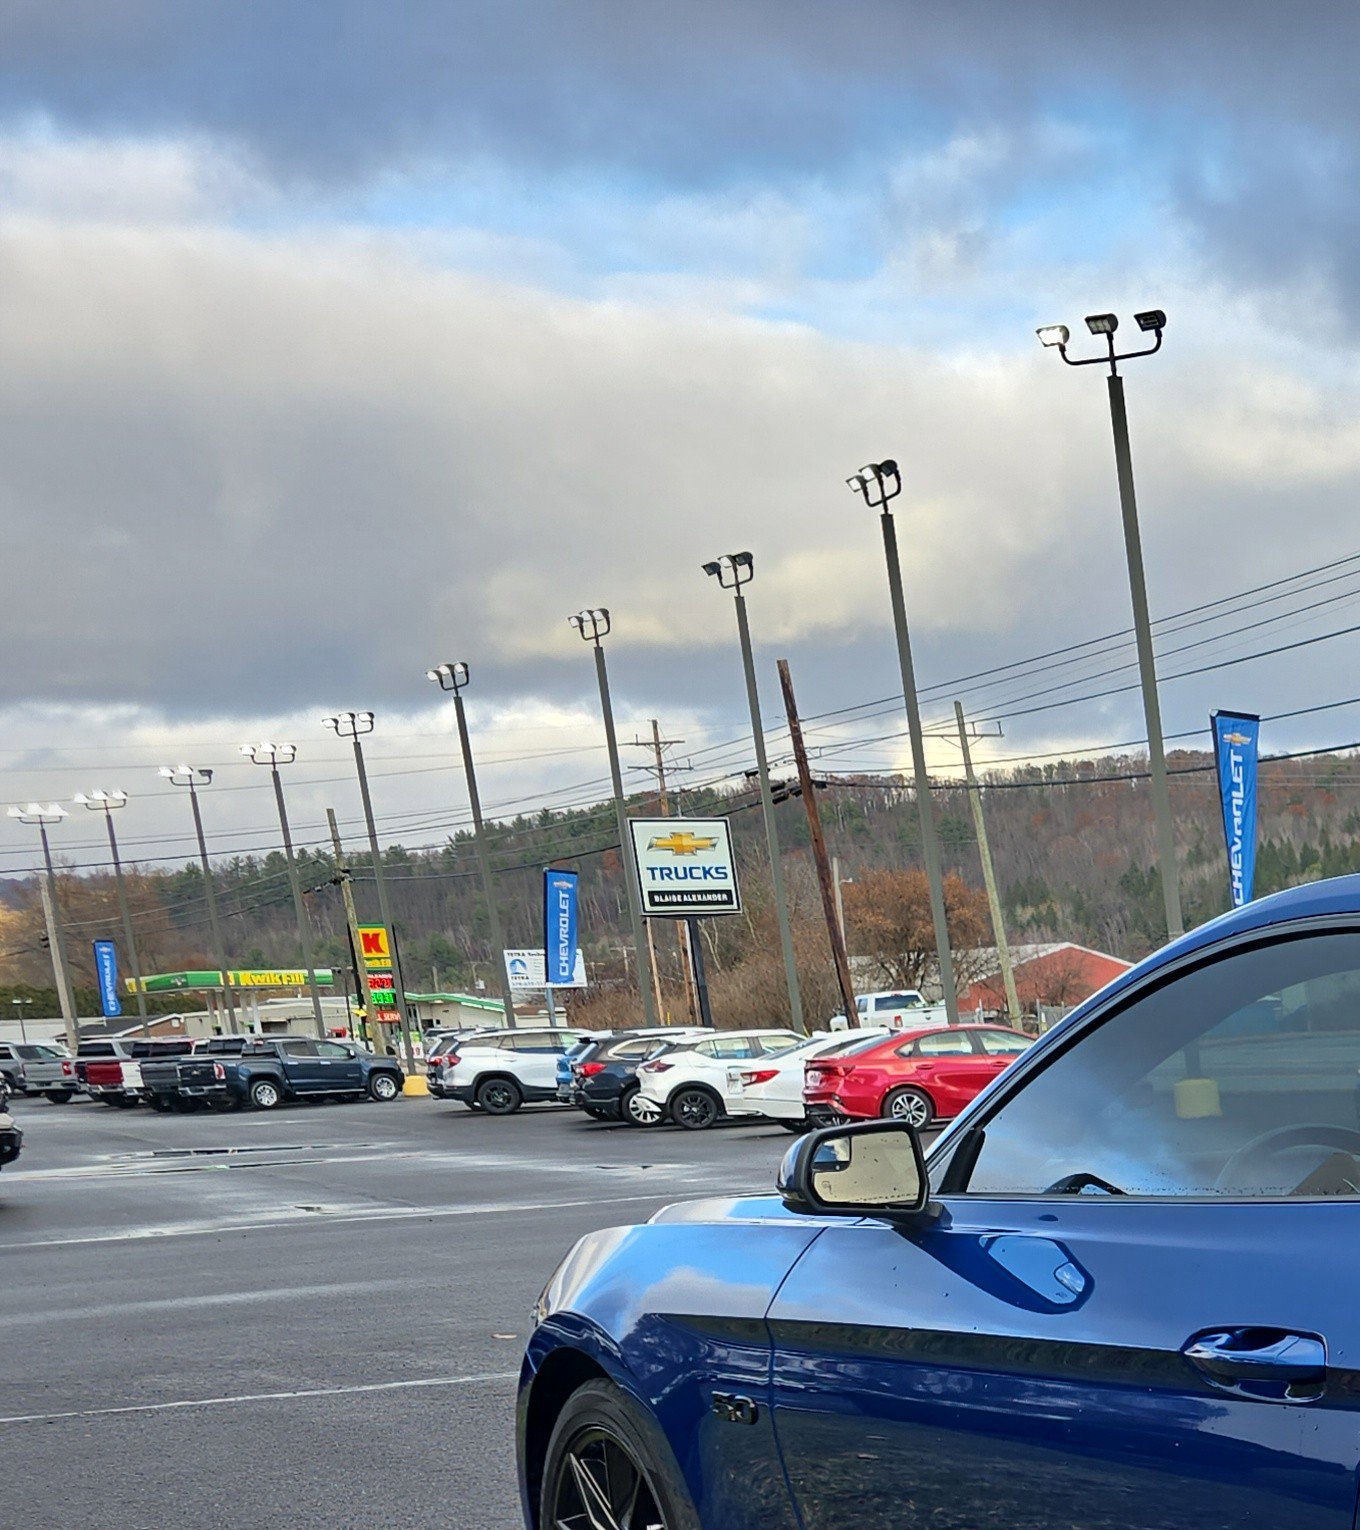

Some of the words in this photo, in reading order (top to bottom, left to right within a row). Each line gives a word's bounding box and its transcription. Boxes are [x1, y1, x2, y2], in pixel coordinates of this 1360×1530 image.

[646, 866, 728, 880] TRUCKS
[653, 894, 682, 903] BLAISE
[683, 893, 728, 902] ALEXANDER
[558, 890, 570, 976] CHEVROLET
[361, 933, 384, 954] K
[239, 972, 282, 986] Kwik
